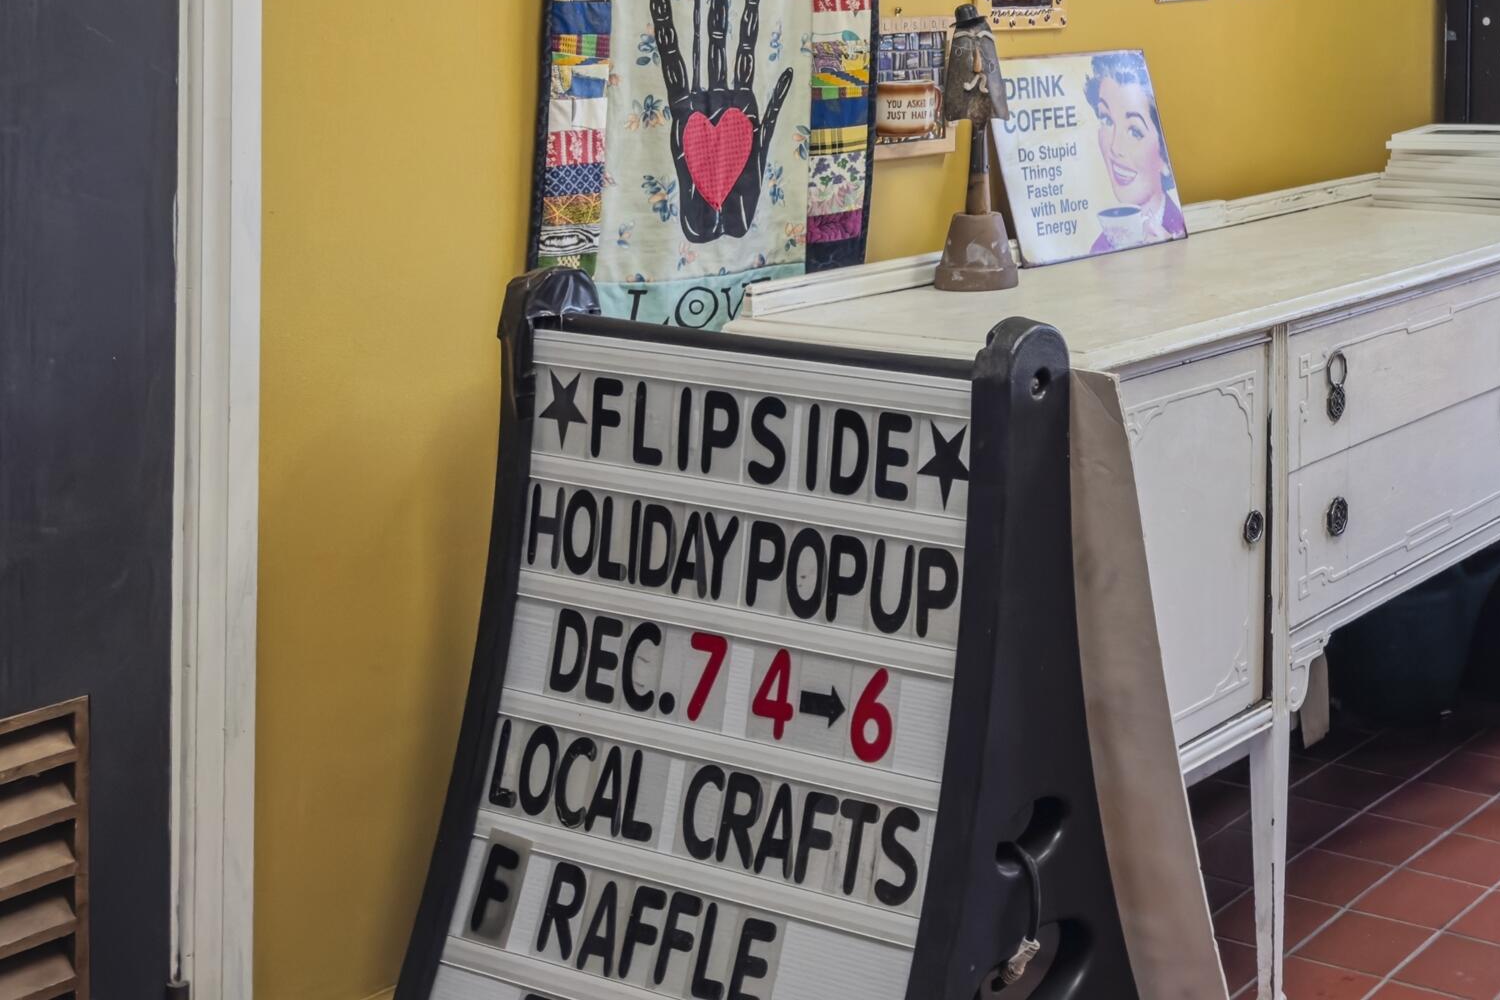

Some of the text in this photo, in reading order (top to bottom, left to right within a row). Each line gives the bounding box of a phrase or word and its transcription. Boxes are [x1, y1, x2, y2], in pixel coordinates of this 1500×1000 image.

[1004, 74, 1065, 101] DRINK
[886, 99, 902, 109] YOU
[886, 110, 906, 120] JUST
[1003, 105, 1078, 134] COFFEE
[1018, 142, 1077, 163] Do Stupid
[1021, 163, 1063, 185] Things
[1027, 183, 1064, 200] Faster
[1031, 198, 1089, 219] with More
[1036, 218, 1078, 237] Energy
[590, 376, 914, 501] FLIPSIDE
[526, 482, 959, 639] HOLIDAY POPUP
[751, 648, 793, 740] 4
[850, 667, 893, 763] 6
[487, 717, 921, 906] LOCAL CRAFTS
[536, 860, 777, 1000] RAFFLE
